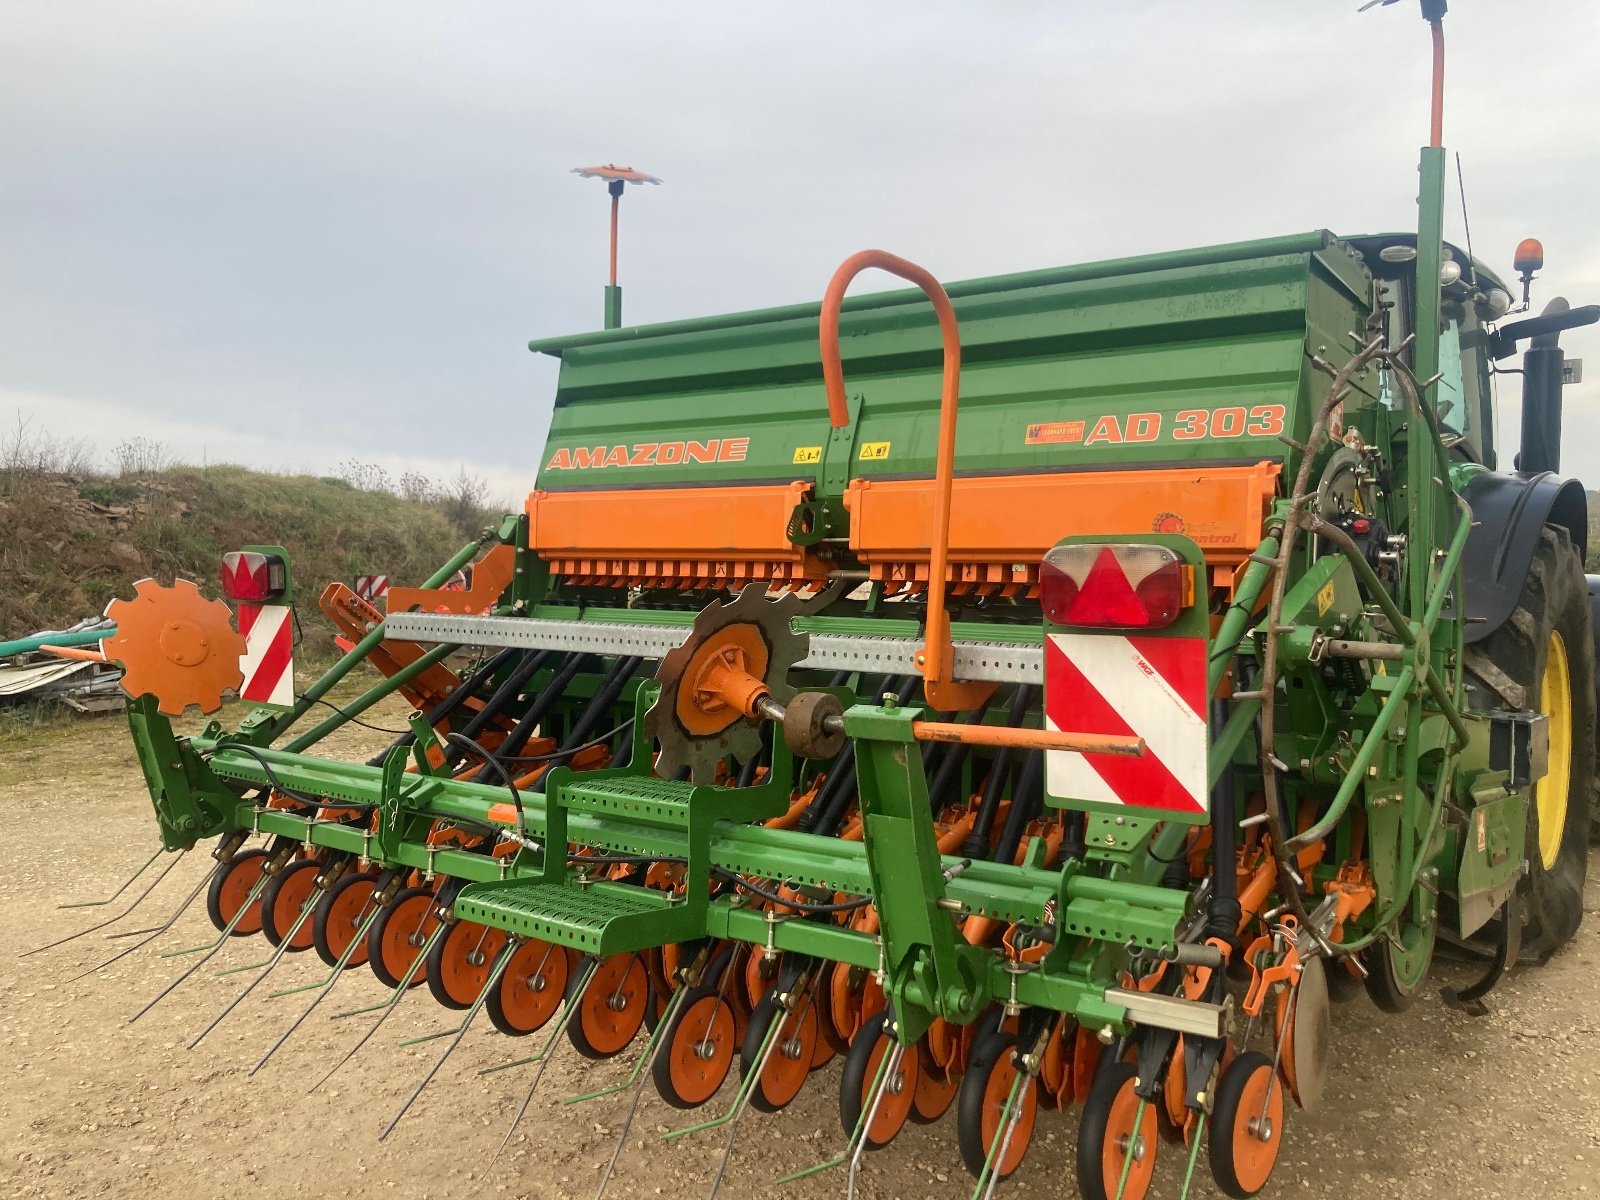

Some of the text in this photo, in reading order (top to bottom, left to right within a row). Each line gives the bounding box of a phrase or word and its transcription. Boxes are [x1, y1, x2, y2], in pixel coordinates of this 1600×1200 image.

[1084, 404, 1286, 445] AD 303
[546, 438, 750, 469] AMAZONE
